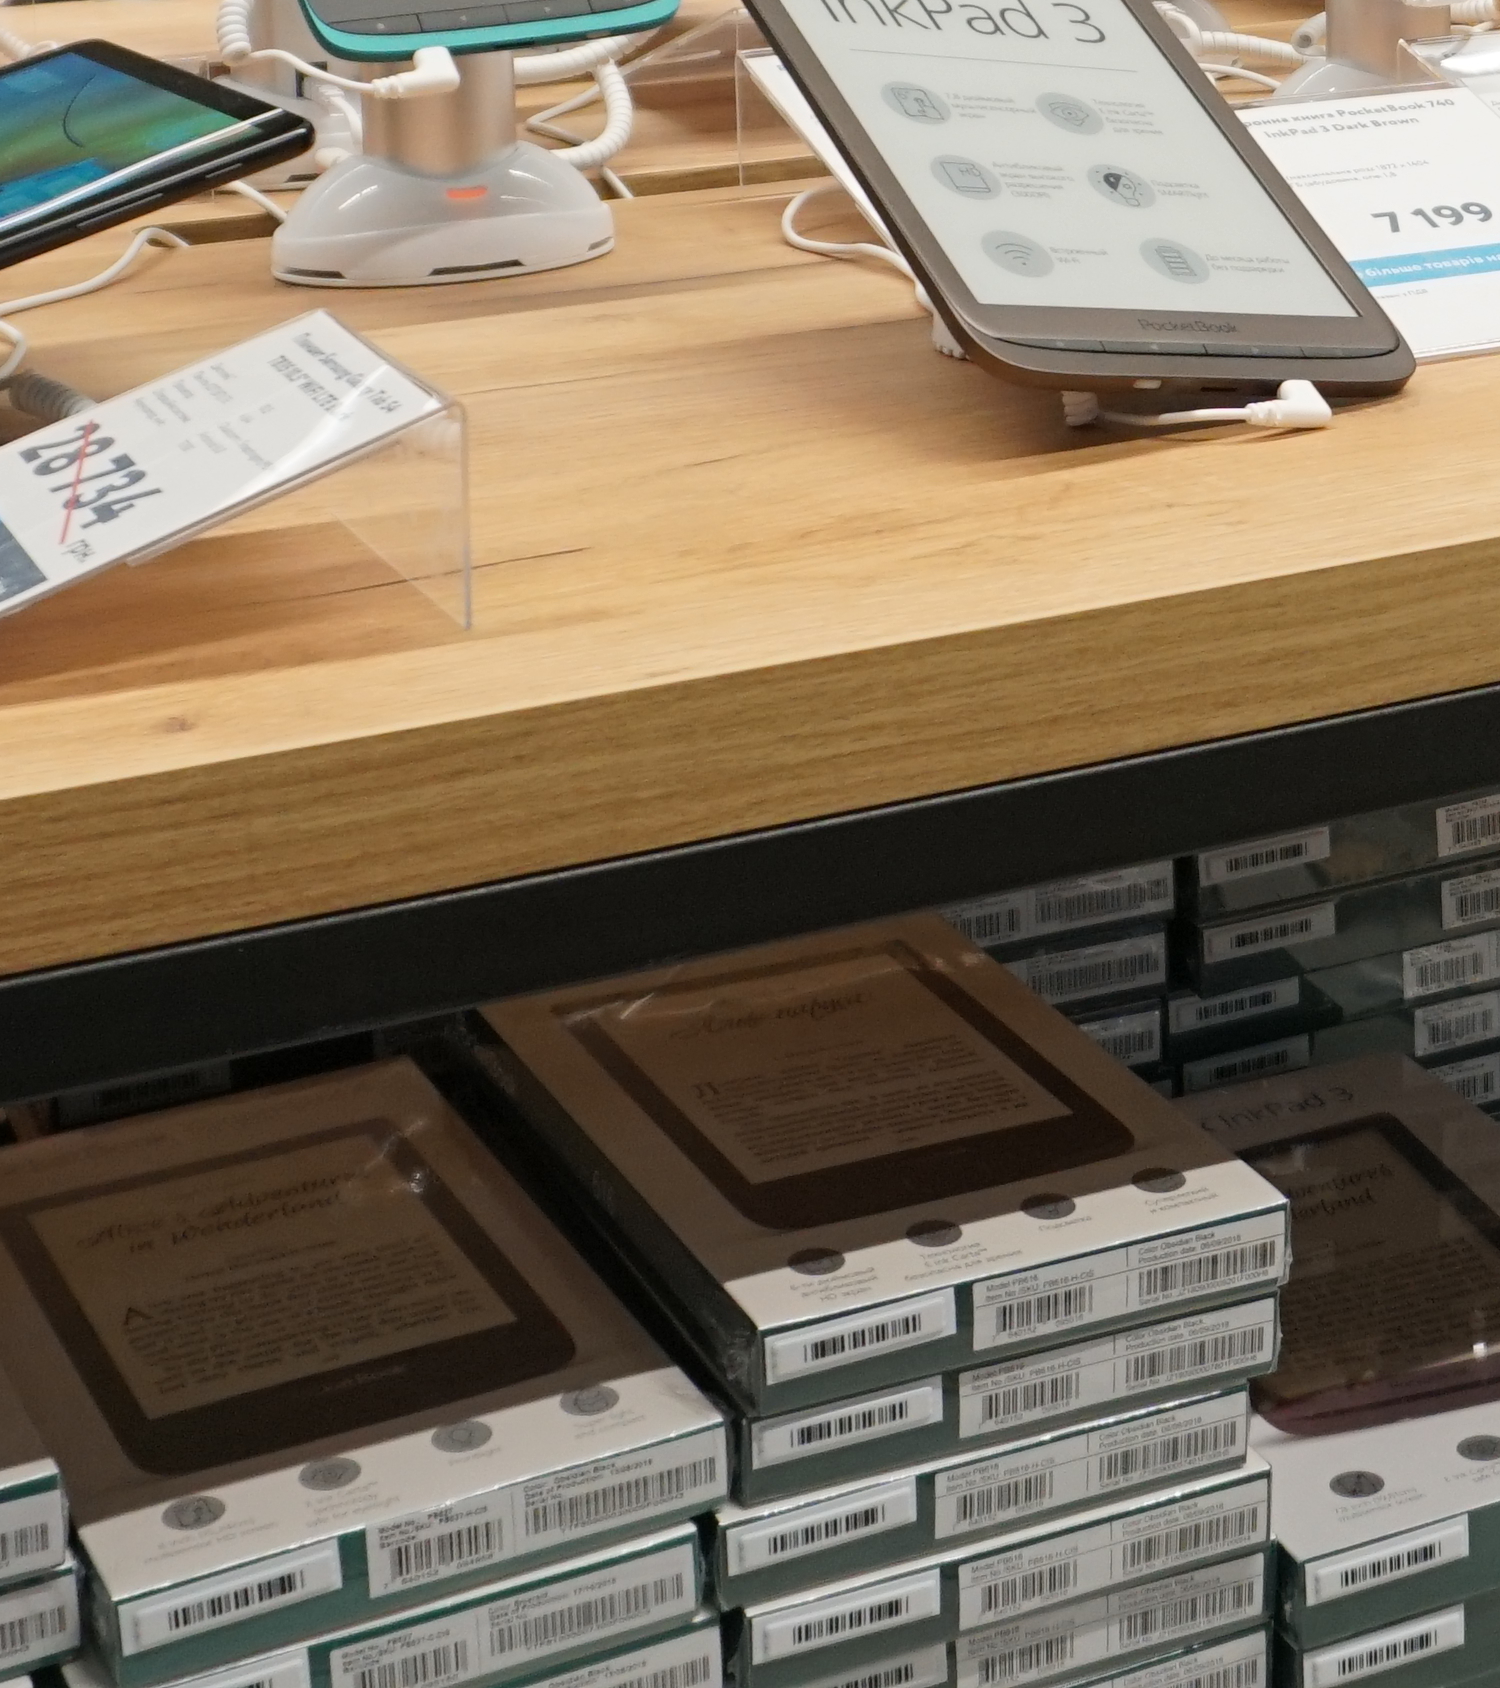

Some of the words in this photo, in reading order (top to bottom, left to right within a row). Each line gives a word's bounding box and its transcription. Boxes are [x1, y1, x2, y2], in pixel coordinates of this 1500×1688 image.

[1052, 3, 1108, 44] 3
[1335, 100, 1426, 118] PocketBook
[1425, 98, 1457, 108] 740
[1263, 125, 1319, 139] InkPad
[1331, 121, 1371, 131] Dark
[1369, 115, 1420, 127] Brown
[1371, 211, 1401, 234] 7
[1409, 200, 1494, 229] 199
[1363, 262, 1423, 277] більше
[1422, 254, 1485, 270] товарів
[1138, 318, 1239, 335] PocketBook
[16, 419, 119, 480] 28
[45, 451, 168, 532] 734
[57, 537, 99, 567] грн.
